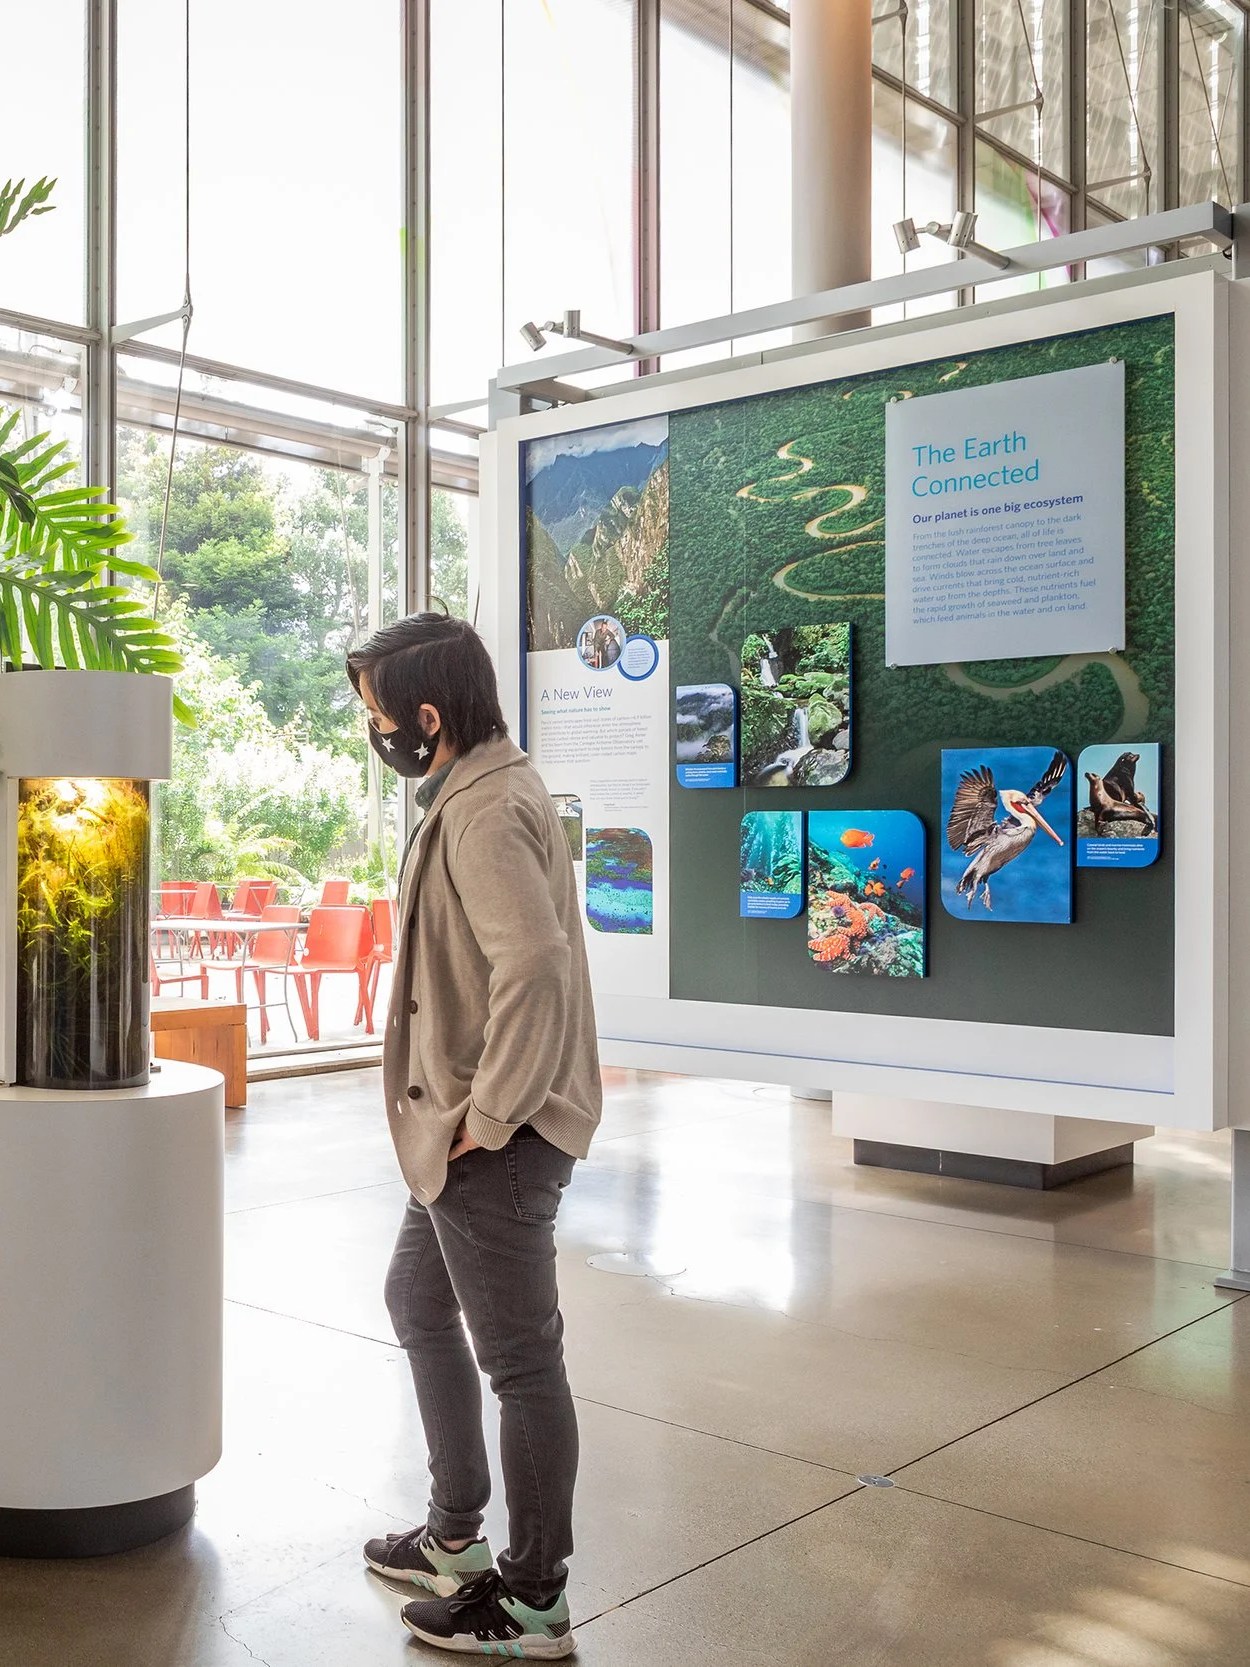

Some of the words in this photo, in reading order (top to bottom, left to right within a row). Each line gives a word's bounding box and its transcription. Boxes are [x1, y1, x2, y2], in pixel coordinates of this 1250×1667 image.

[912, 444, 956, 466] The
[964, 431, 1026, 459] Earth
[912, 459, 1039, 497] Connected
[913, 514, 932, 524] Our
[935, 508, 967, 524] planet
[970, 507, 979, 516] is
[982, 506, 1001, 515] one
[1004, 501, 1021, 514] big
[1024, 495, 1083, 509] ecosystem
[913, 533, 932, 541] From
[933, 530, 946, 538] the
[948, 527, 964, 536] lush
[966, 522, 1003, 534] rainforest
[1005, 521, 1035, 530] canopy
[1047, 516, 1061, 524] the
[1063, 513, 1081, 522] dark
[913, 541, 946, 551] trenches
[957, 538, 970, 546] the
[971, 536, 991, 545] deep
[1021, 530, 1030, 538] all
[1042, 527, 1055, 536] life
[541, 690, 550, 701] A
[554, 689, 579, 700] New
[584, 686, 612, 698] View
